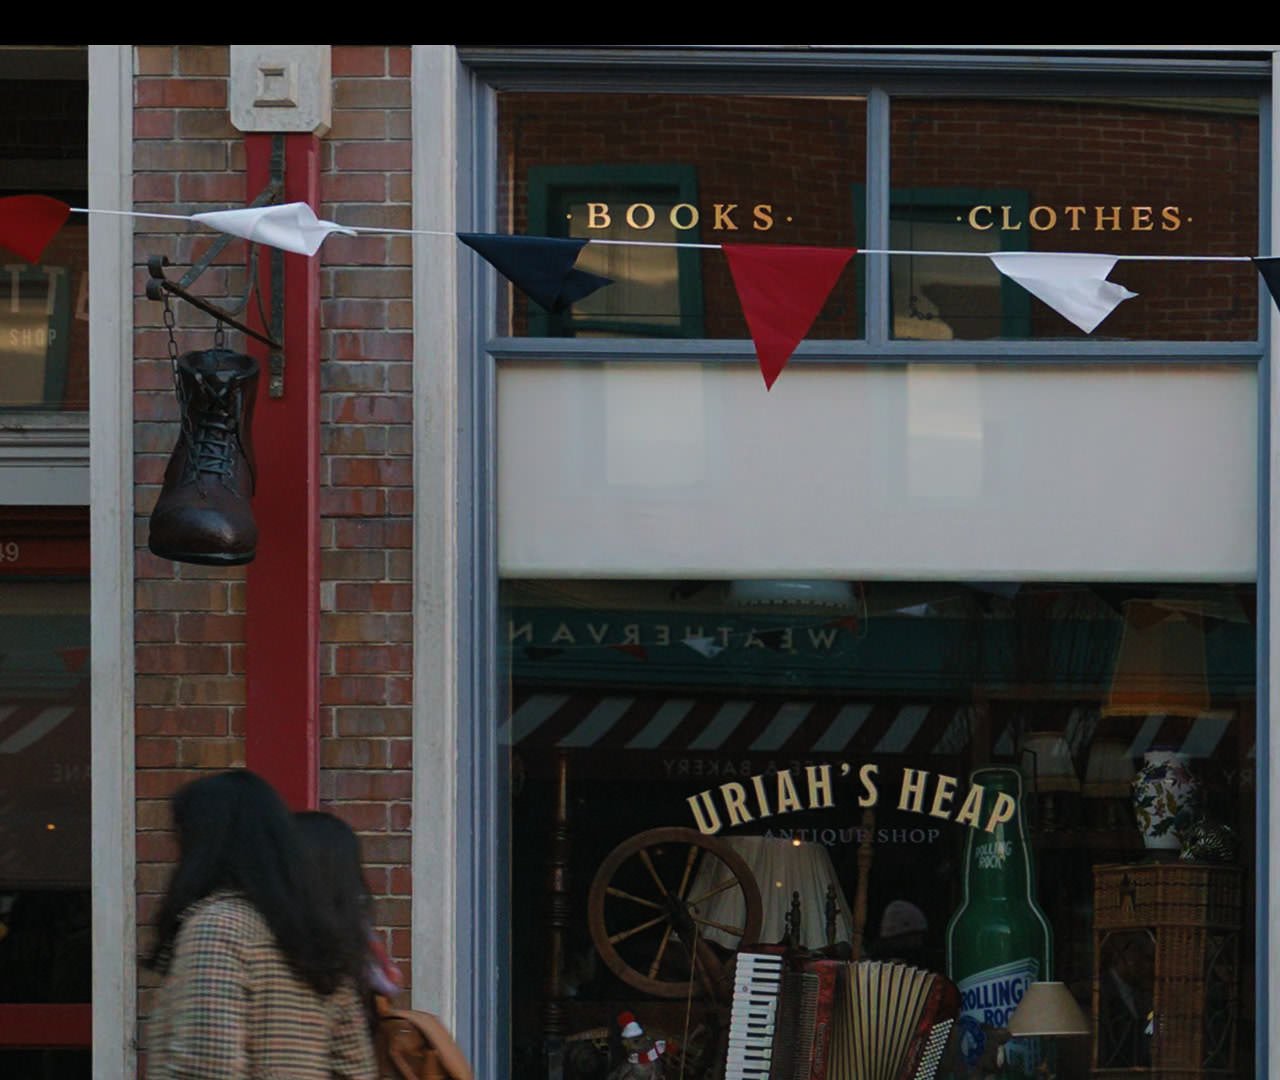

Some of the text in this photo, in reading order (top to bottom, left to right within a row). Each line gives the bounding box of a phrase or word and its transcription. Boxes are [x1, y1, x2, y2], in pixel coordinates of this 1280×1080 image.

[586, 202, 774, 231] BOOKS
[967, 205, 1182, 232] CLOTHES
[0, 541, 20, 562] 9
[687, 764, 1016, 836] URIAH'S HEAP
[762, 828, 941, 845] ANTIQUE SHOP
[961, 978, 1024, 1011] ROLLING
